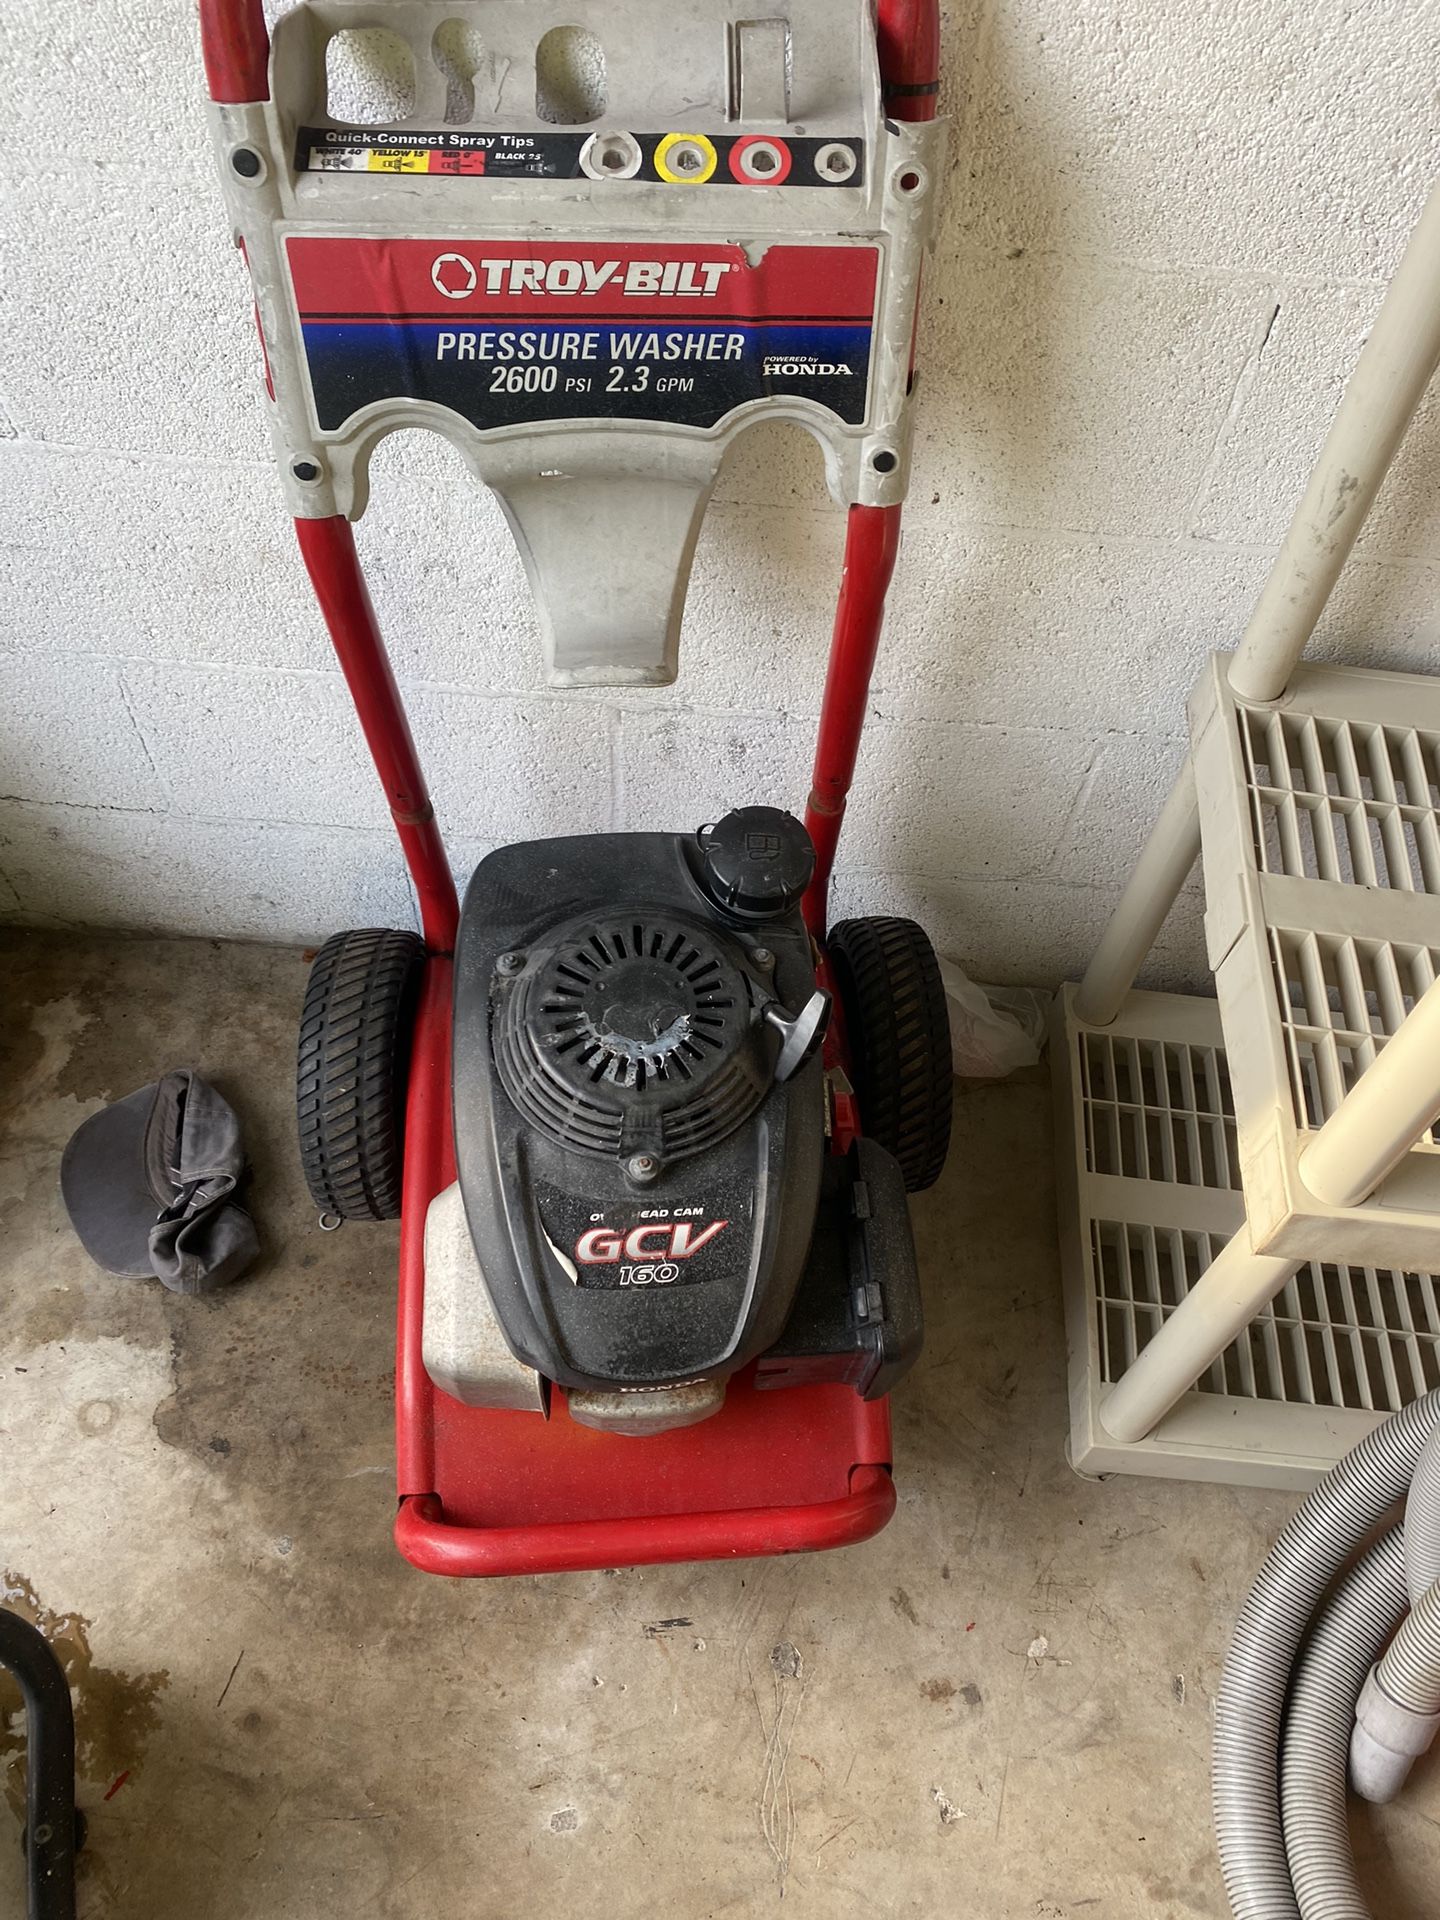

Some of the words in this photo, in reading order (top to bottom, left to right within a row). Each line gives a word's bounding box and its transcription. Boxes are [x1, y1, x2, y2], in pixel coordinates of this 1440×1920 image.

[325, 131, 444, 145] Quick-Connect
[449, 134, 495, 148] Spray
[500, 135, 535, 149] Tips
[372, 149, 412, 157] YELLOW
[494, 152, 526, 160] BLACK
[436, 332, 599, 361] PRESSURE
[609, 333, 745, 361] WASHER
[808, 356, 819, 364] by
[762, 363, 854, 376] HONDA
[489, 365, 558, 393] 2600
[565, 378, 592, 392] PSI
[605, 366, 650, 393] 2.3
[656, 378, 695, 393] GPM
[673, 1207, 704, 1217] CAM
[575, 1221, 729, 1264] GCV
[620, 1263, 679, 1286] 160
